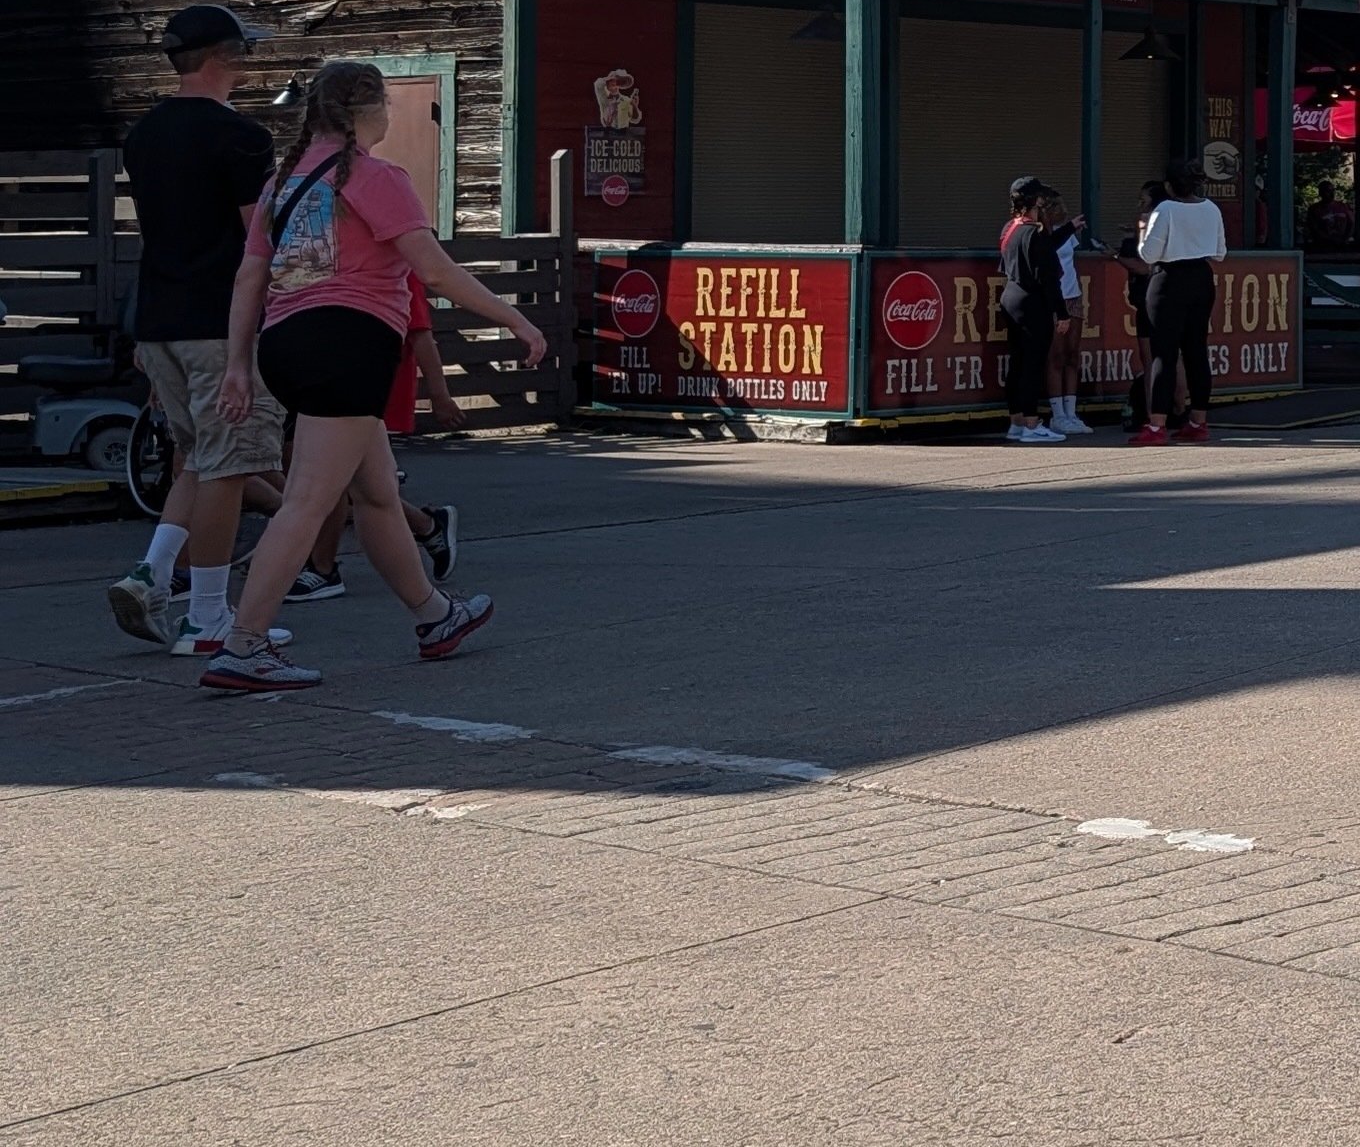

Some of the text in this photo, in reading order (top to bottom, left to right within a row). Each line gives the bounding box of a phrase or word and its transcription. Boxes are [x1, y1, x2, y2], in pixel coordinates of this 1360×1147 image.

[1208, 97, 1233, 117] THIS
[1209, 118, 1232, 138] WAY
[590, 140, 642, 157] ICE COLD
[590, 158, 641, 173] DELICIOUS
[696, 267, 806, 318] REFILL
[887, 299, 939, 323] Coca-Cola
[620, 345, 650, 369] FILL
[678, 321, 823, 375] STATION
[885, 358, 939, 395] FILL
[947, 356, 984, 391] 'ER
[1080, 350, 1135, 384] RINK
[1240, 341, 1290, 374] ONLY
[607, 371, 662, 394] 'ER UP!
[678, 376, 828, 402] DRINK BOTTLES ONLY
